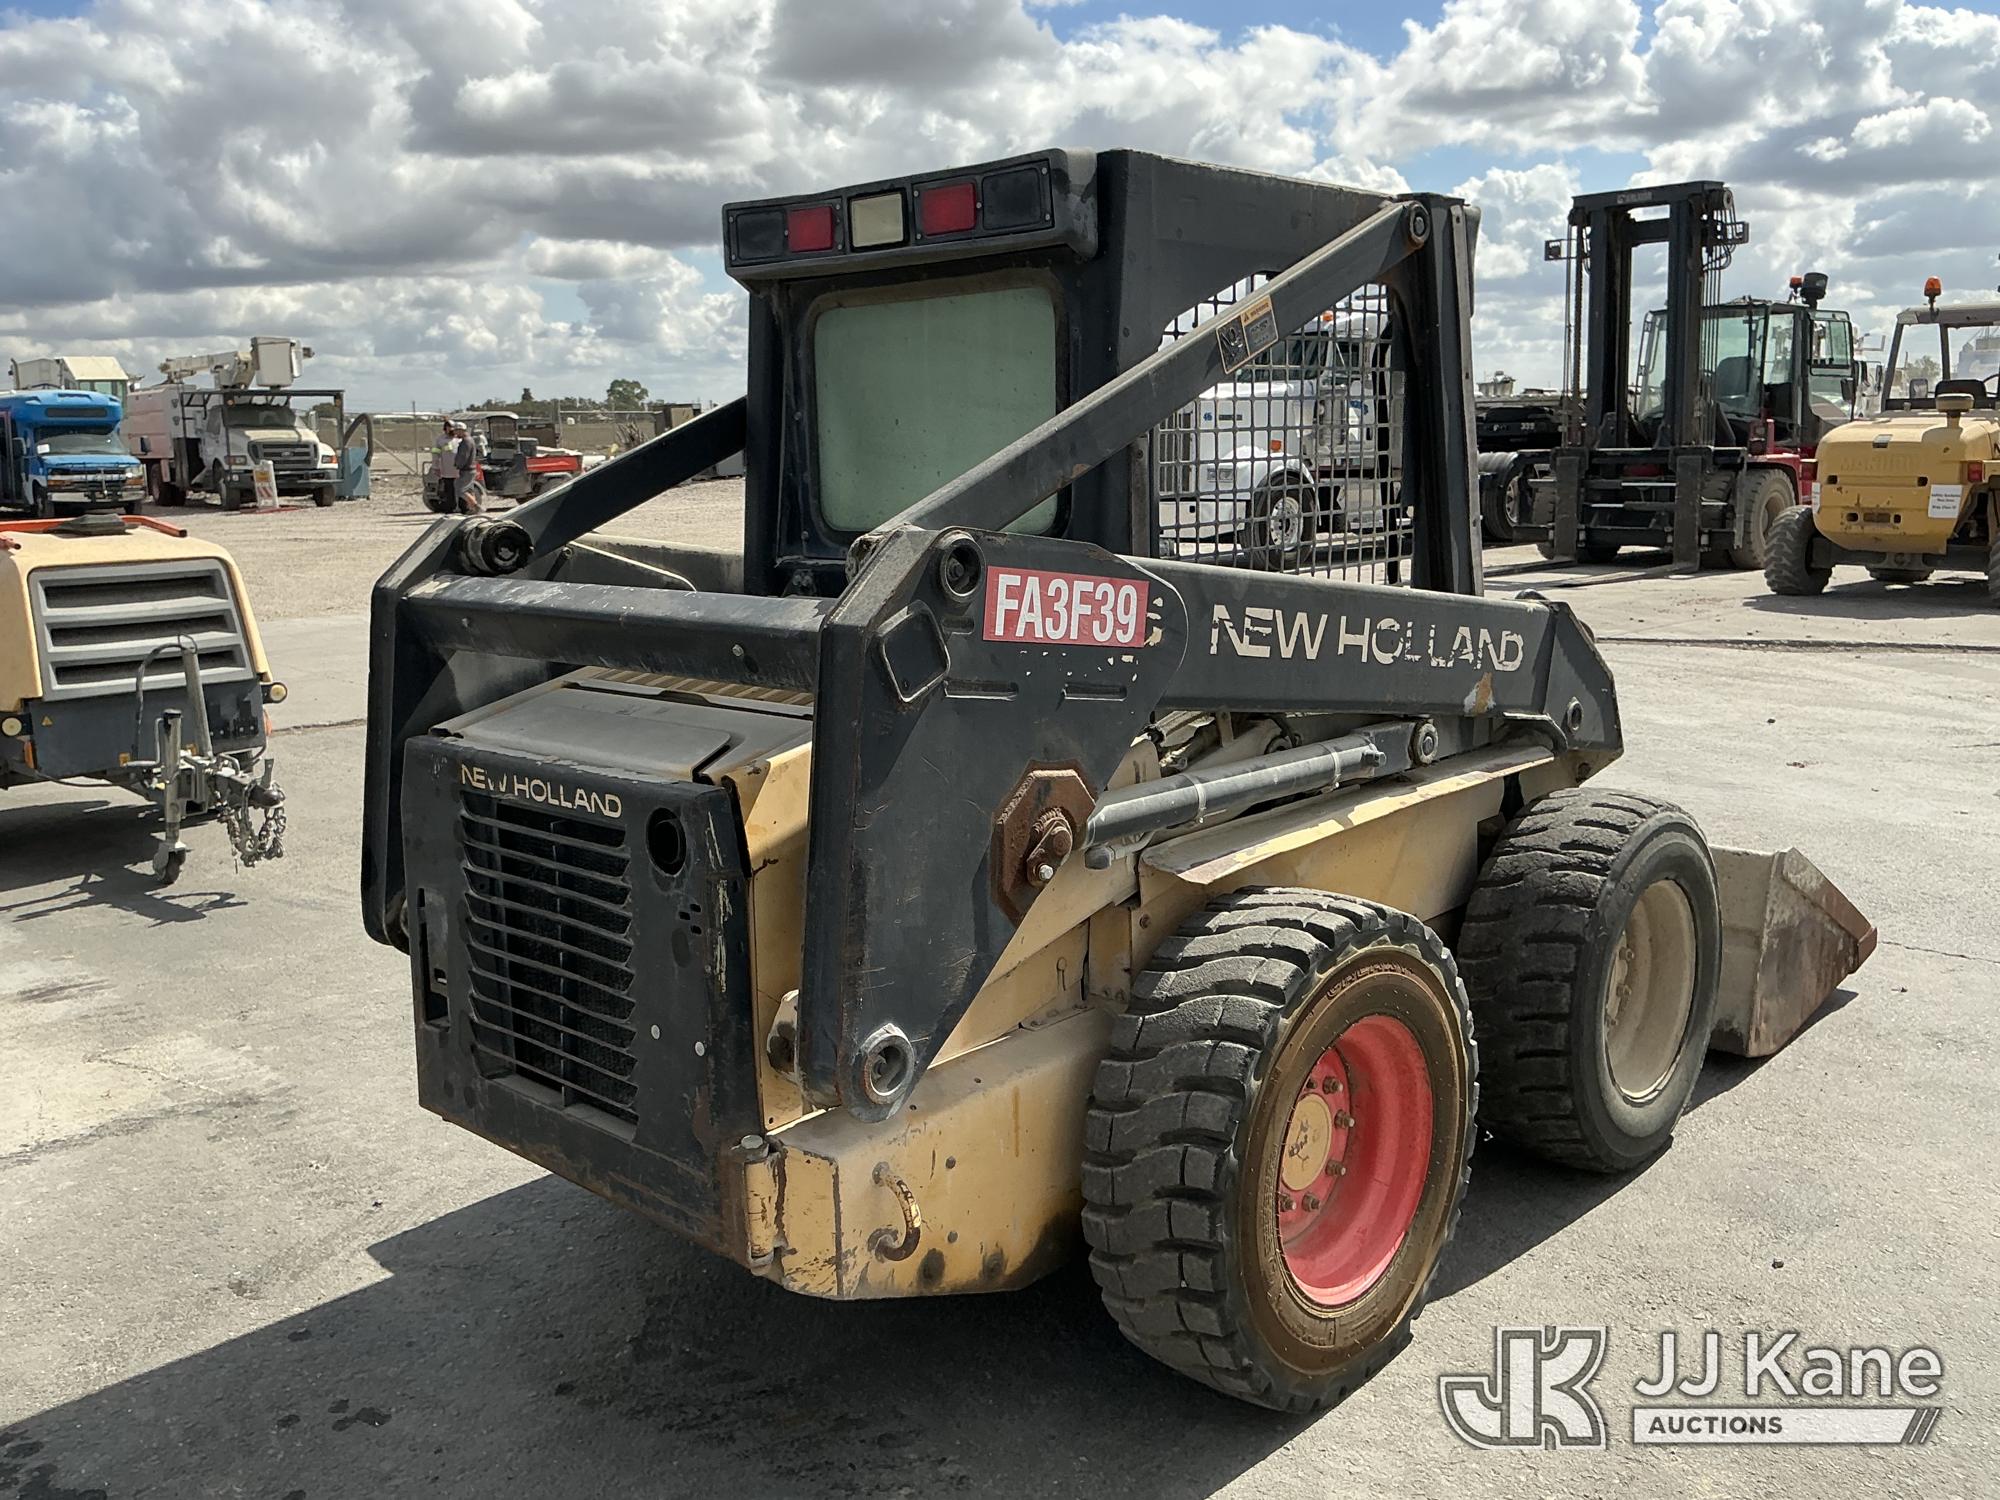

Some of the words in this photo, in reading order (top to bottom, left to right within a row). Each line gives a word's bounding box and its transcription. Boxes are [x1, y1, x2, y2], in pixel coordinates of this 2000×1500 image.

[994, 573, 1138, 644] FA3F39
[1209, 604, 1329, 660] NEW
[1337, 617, 1524, 672] HOLLAND
[461, 764, 507, 793] NEW
[513, 775, 622, 818] HOLLAND
